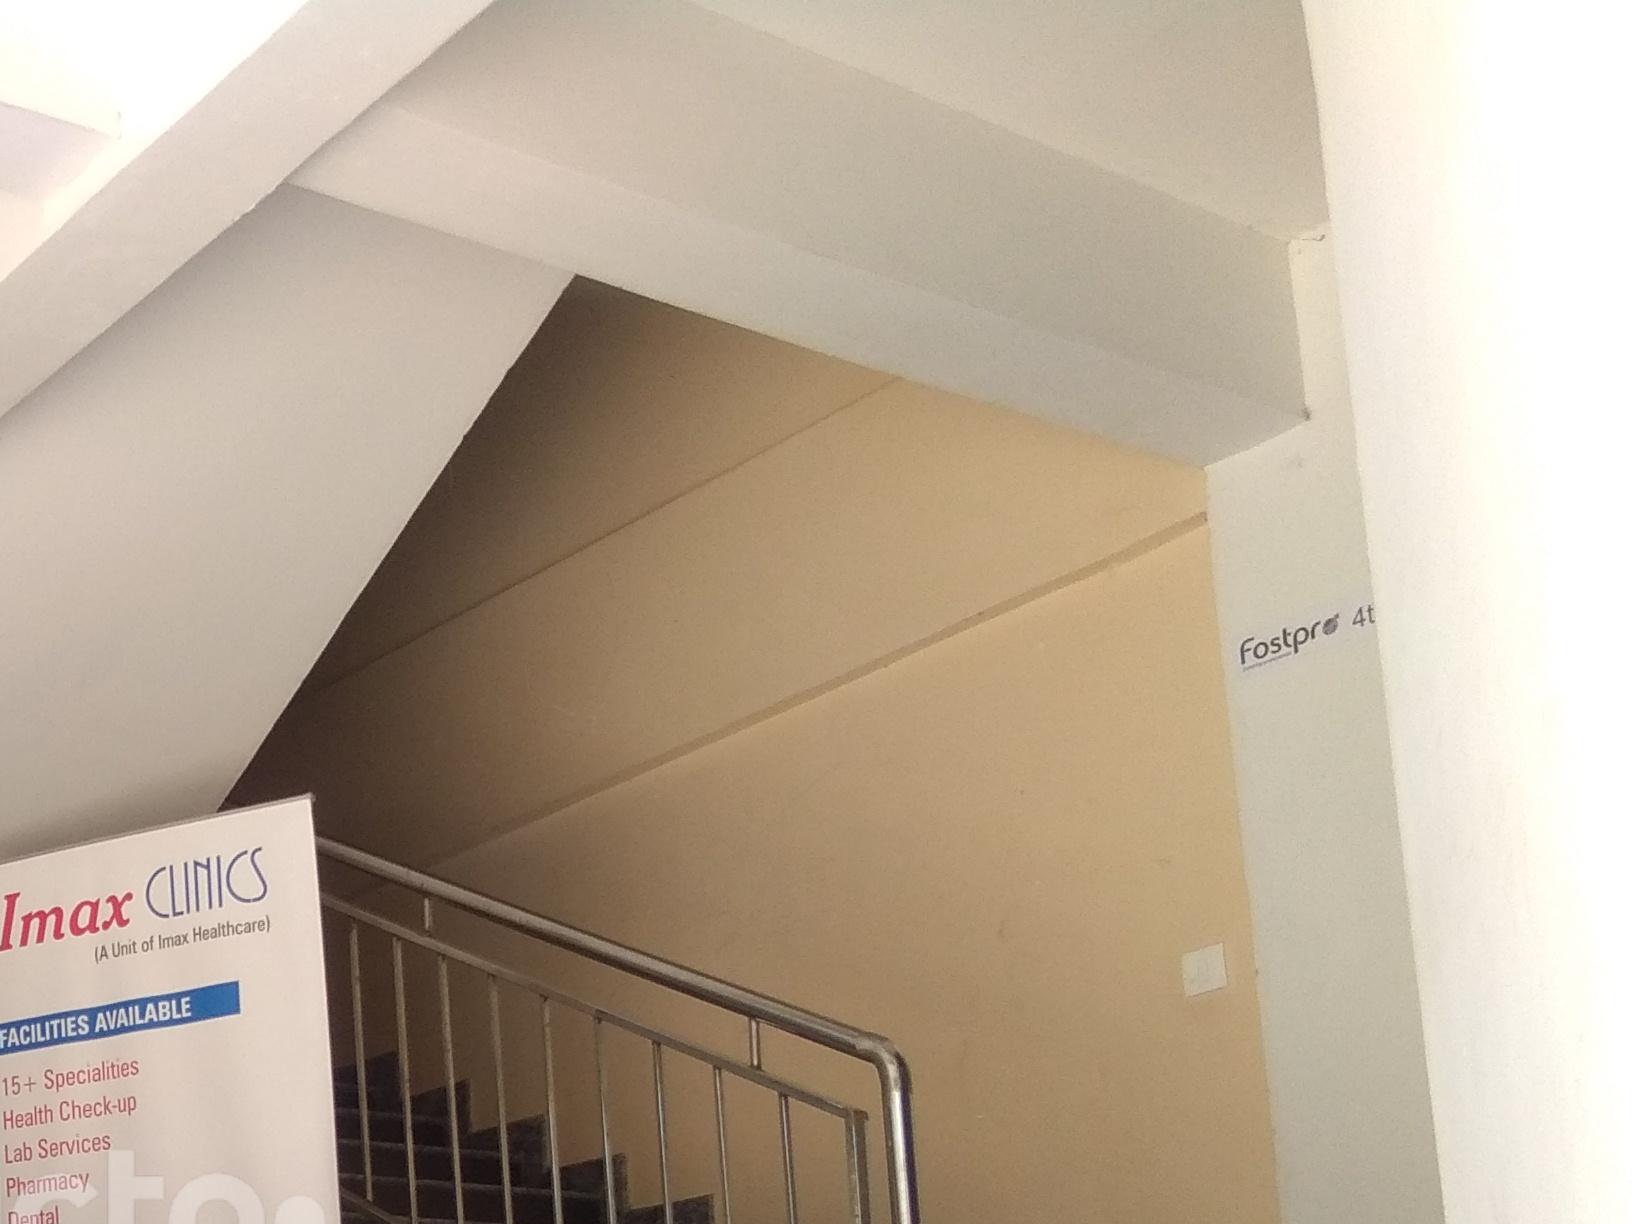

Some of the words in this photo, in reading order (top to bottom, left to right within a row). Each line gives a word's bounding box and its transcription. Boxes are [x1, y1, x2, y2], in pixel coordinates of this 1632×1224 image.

[1352, 604, 1375, 627] 4t
[145, 847, 268, 918] CLINICS
[94, 945, 109, 964] (A
[112, 939, 137, 958] Unit
[142, 935, 154, 952] of
[158, 931, 189, 949] Imax
[193, 916, 271, 944] Healthcare)
[0, 1014, 89, 1049] FACILITIES
[94, 996, 192, 1033] AVAILABLE
[1, 1074, 37, 1097] 15+
[44, 1058, 139, 1091] Specialities
[3, 1102, 53, 1130] Health
[59, 1094, 137, 1121] Check-up
[5, 1138, 33, 1164] Lab
[38, 1132, 111, 1159] Services
[6, 1172, 89, 1198] Pharmacy
